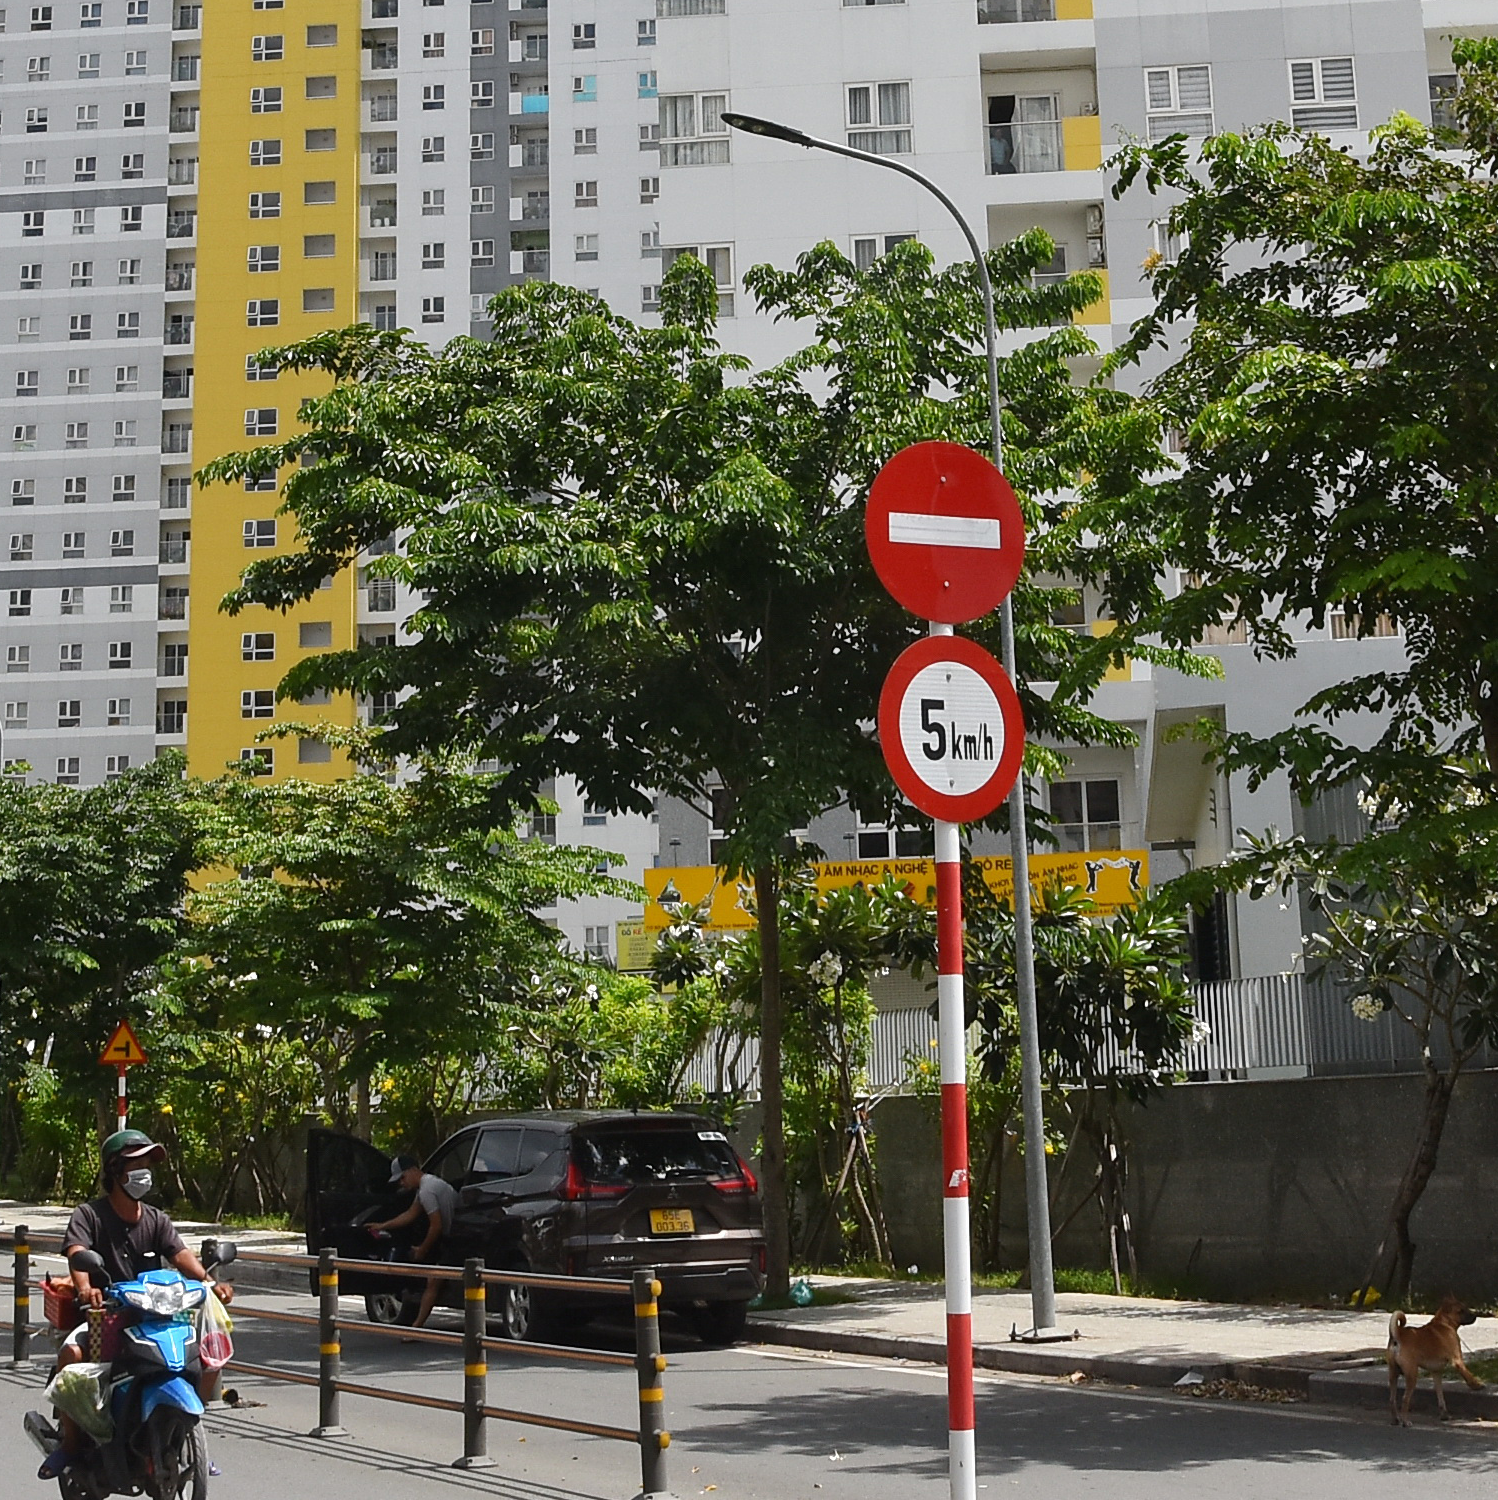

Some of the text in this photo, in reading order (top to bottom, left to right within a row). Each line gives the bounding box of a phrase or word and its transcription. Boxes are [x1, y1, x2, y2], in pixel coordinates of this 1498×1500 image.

[921, 698, 993, 761] 5 km/h
[824, 864, 843, 877] ÂM
[845, 865, 879, 878] NHẠC
[894, 861, 928, 875] NGHỆ
